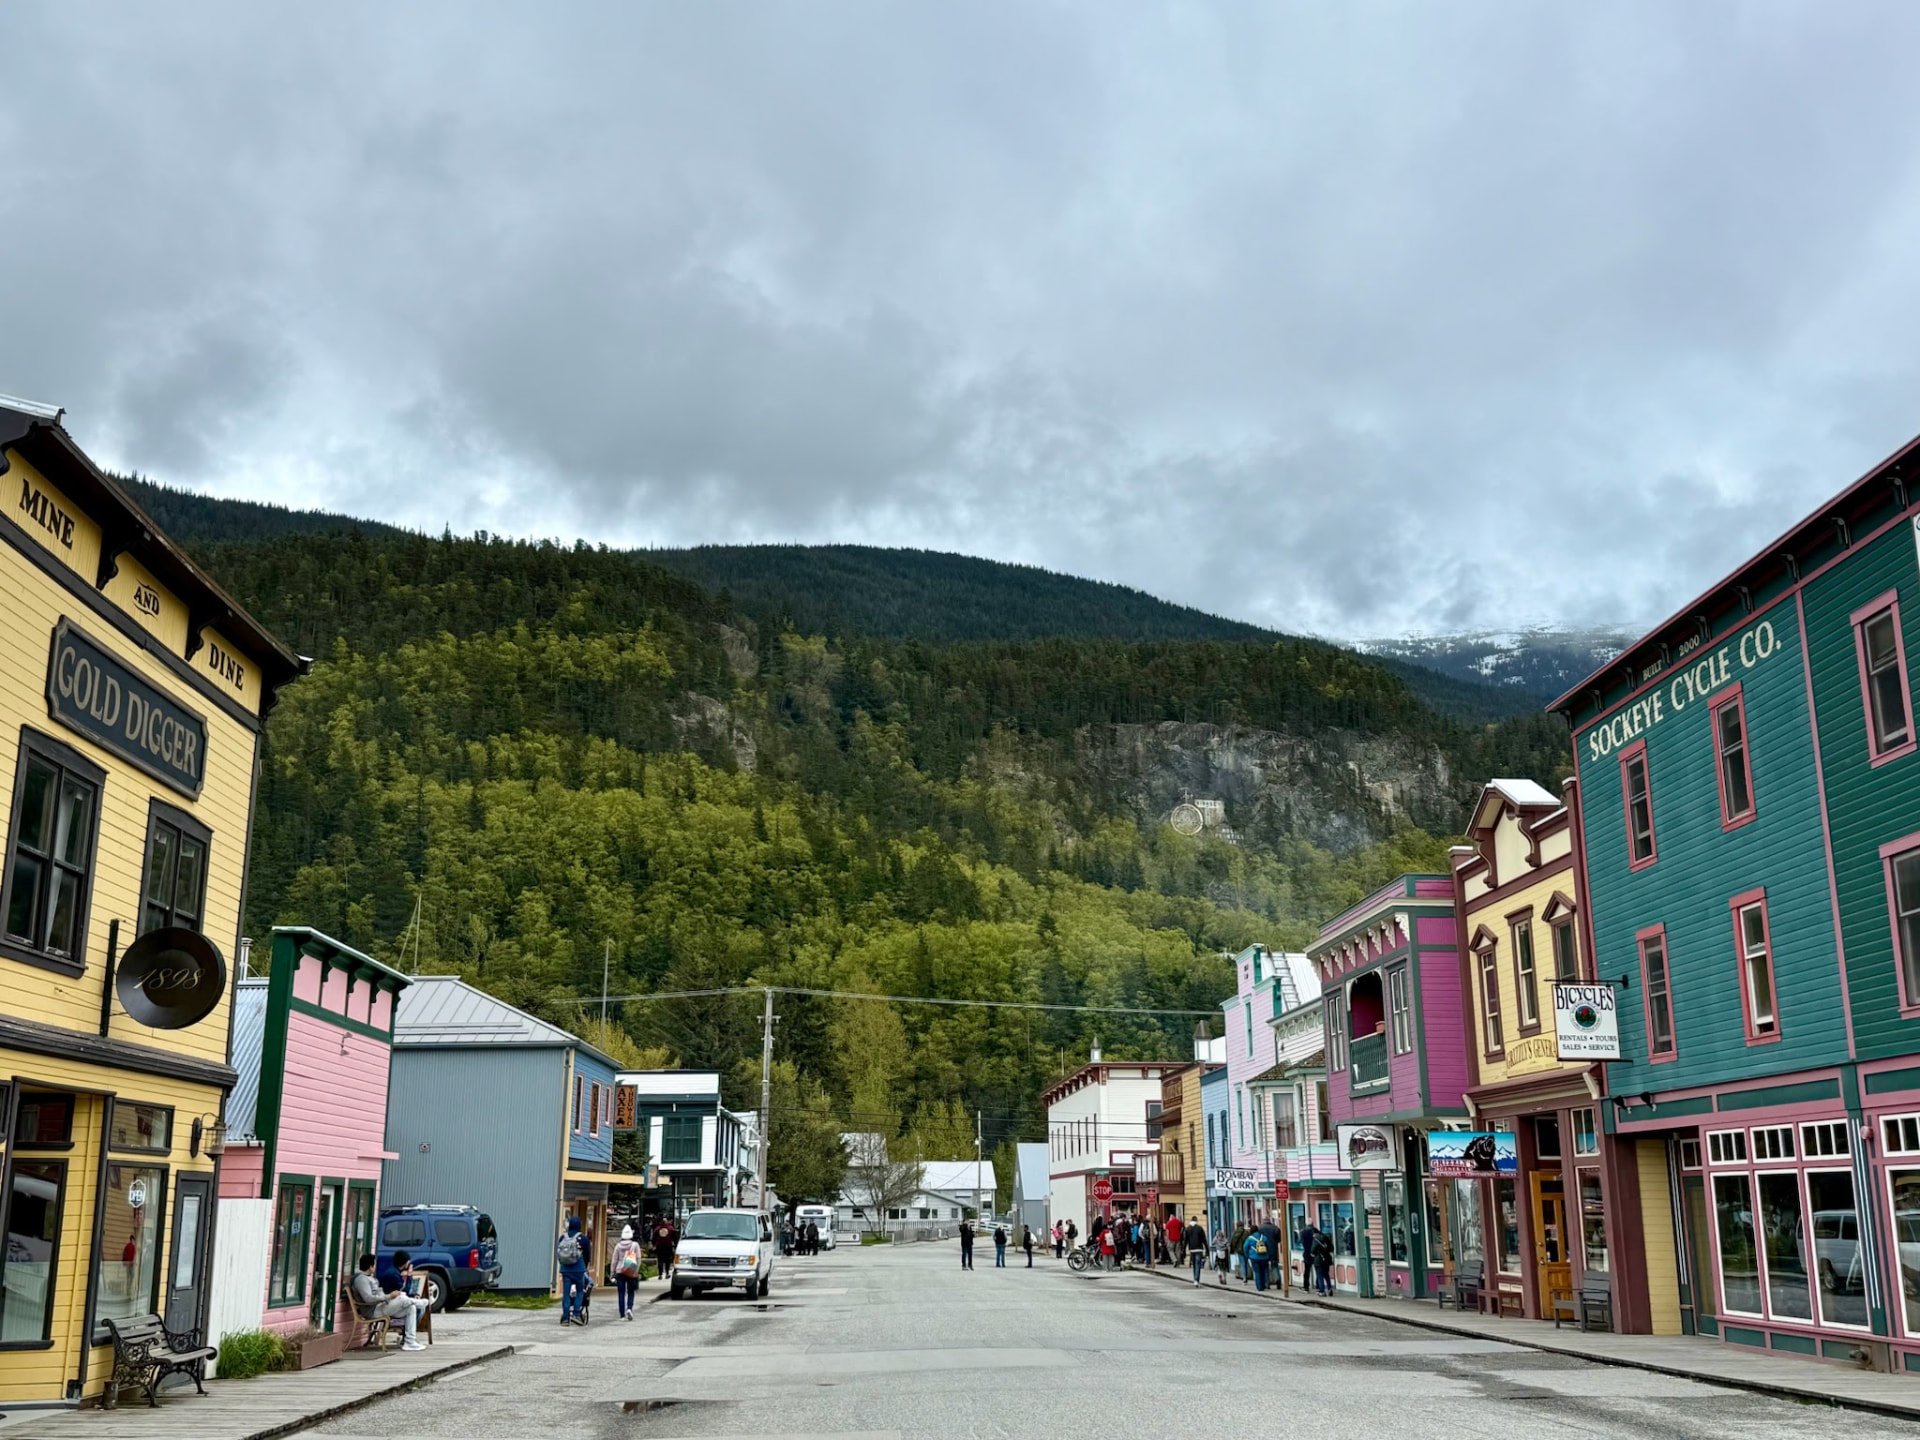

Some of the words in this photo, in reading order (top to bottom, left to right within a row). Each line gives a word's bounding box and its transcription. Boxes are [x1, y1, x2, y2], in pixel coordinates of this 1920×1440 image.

[19, 478, 75, 549] MINE
[133, 586, 160, 616] AND
[209, 642, 243, 691] DINE
[1642, 659, 1662, 681] BUILT
[1678, 634, 1700, 657] 2000
[1589, 690, 1664, 762] SOCKEYE
[1670, 646, 1731, 711] CYCLE
[1739, 620, 1782, 668] CO.
[58, 645, 120, 728] GOLD
[125, 690, 198, 778] DIGGER
[133, 967, 206, 991] 1898
[1555, 986, 1614, 1011] BICYCLES
[1559, 1034, 1588, 1042] RENTALS
[1588, 1043, 1616, 1051] SERVICE
[617, 1087, 627, 1117] AXE
[1217, 1169, 1256, 1183] BOMBAY
[1225, 1178, 1255, 1190] CURRY
[1094, 1186, 1111, 1195] STOP
